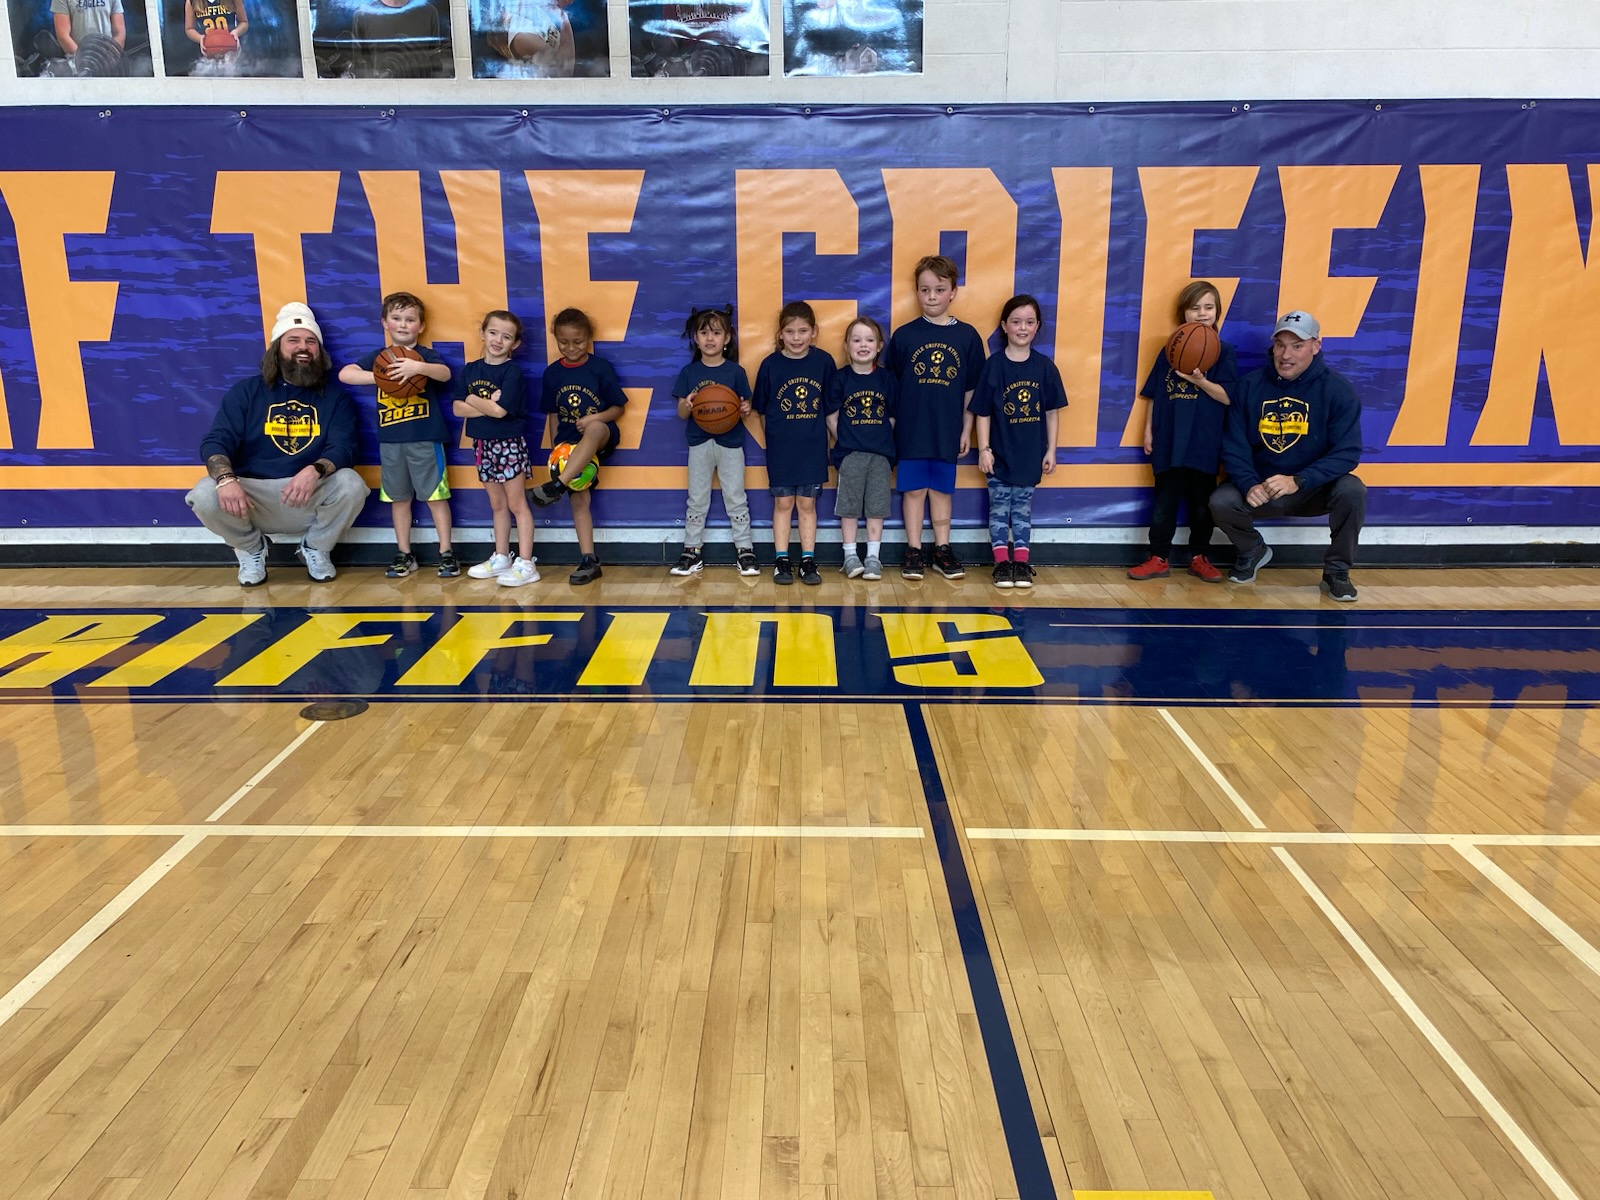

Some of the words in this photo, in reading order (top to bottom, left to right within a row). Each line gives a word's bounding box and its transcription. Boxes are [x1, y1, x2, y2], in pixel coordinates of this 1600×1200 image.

[0, 171, 119, 450] F
[209, 168, 652, 450] THE
[925, 342, 947, 350] GRIFFIN
[560, 385, 582, 393] GRIFFIN
[776, 383, 788, 400] LITTLE
[788, 377, 809, 386] GRIFFIN
[1010, 380, 1031, 389] GRIFFIN
[853, 390, 875, 398] GRIFFIN
[384, 404, 424, 422] 2021
